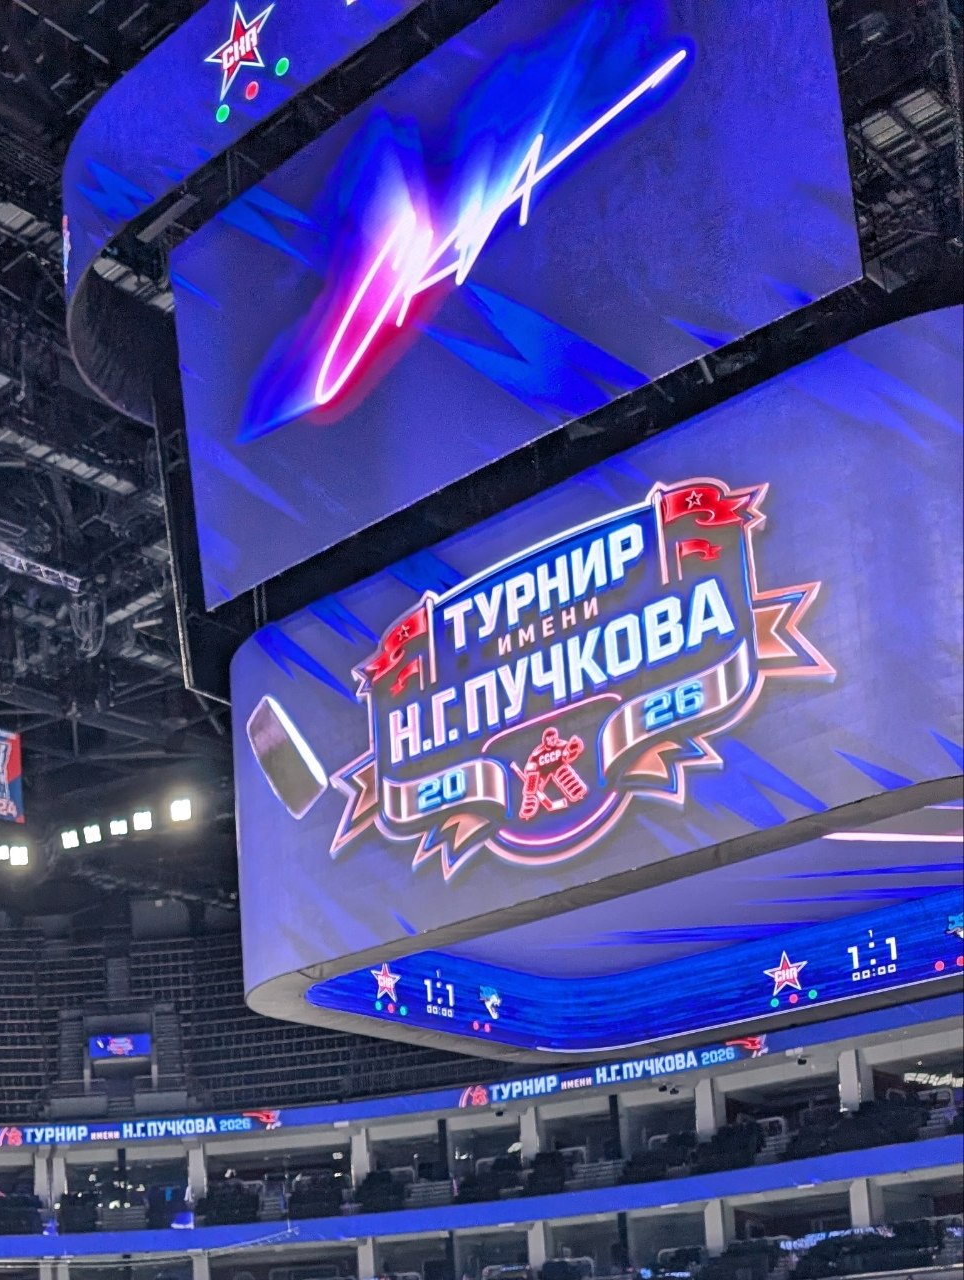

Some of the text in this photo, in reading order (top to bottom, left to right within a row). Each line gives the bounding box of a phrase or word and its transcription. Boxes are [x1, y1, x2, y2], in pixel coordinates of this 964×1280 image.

[222, 26, 258, 70] СКА
[443, 523, 644, 651] ТУРНИР
[497, 597, 599, 656] ИМЕНИ
[417, 681, 704, 811] 20 26
[539, 750, 562, 766] СССР
[490, 1075, 557, 1101] ТУРНИР
[561, 1076, 592, 1091] ИМЕНИ
[701, 1047, 735, 1065] 2026
[24, 1126, 87, 1143] ТУРНИР
[220, 1118, 251, 1132] 2026
